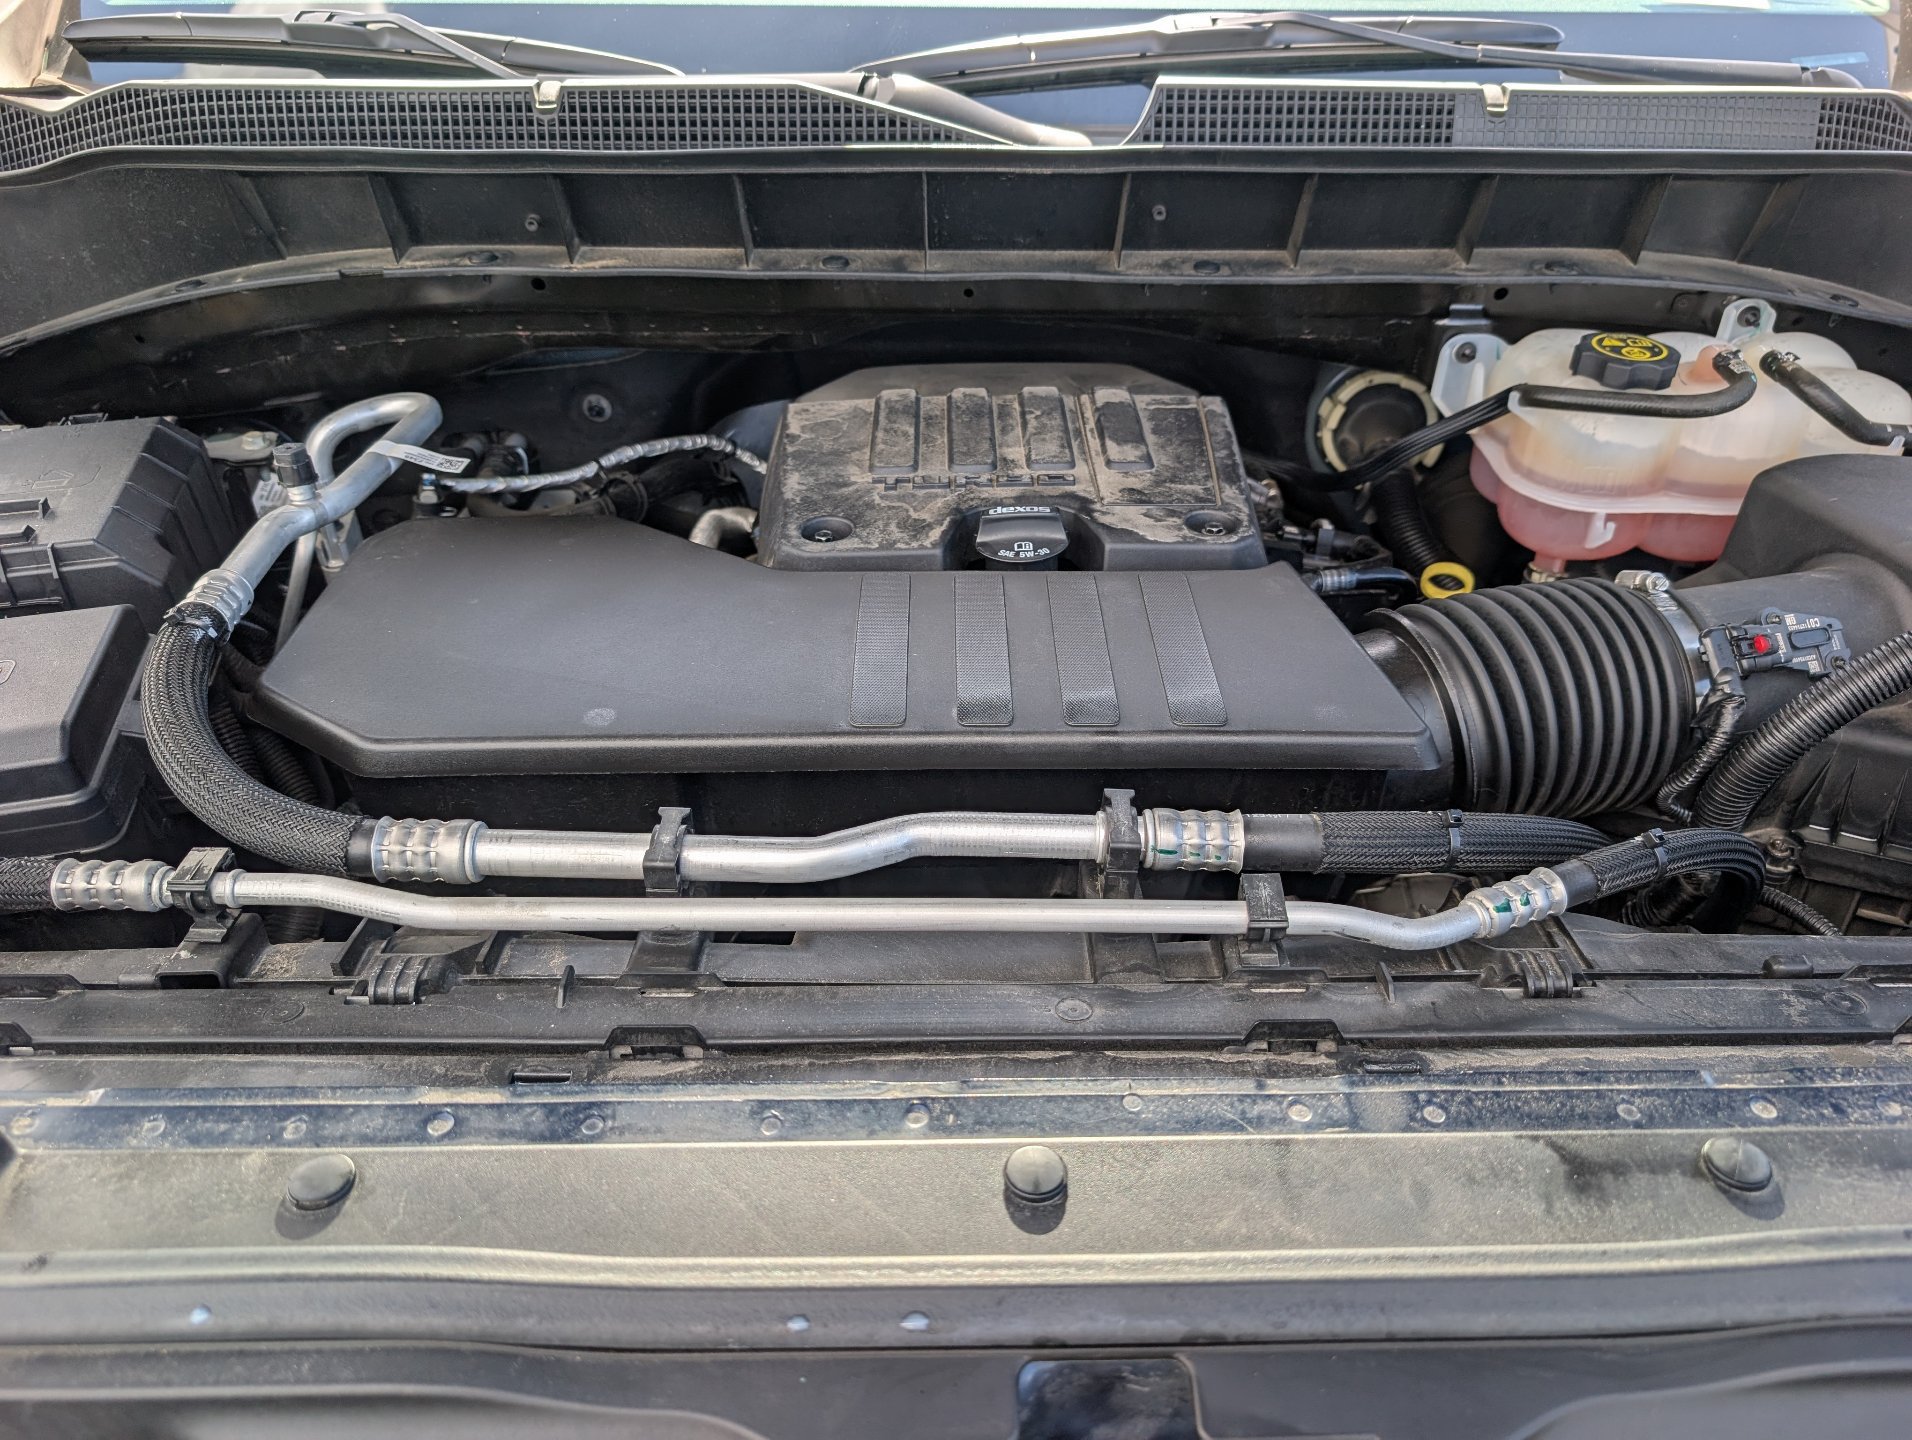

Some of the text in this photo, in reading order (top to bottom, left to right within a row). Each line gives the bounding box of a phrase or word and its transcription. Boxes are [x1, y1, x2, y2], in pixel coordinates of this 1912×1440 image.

[988, 506, 1051, 515] dexos
[997, 547, 1050, 558] SAE 5W-30
